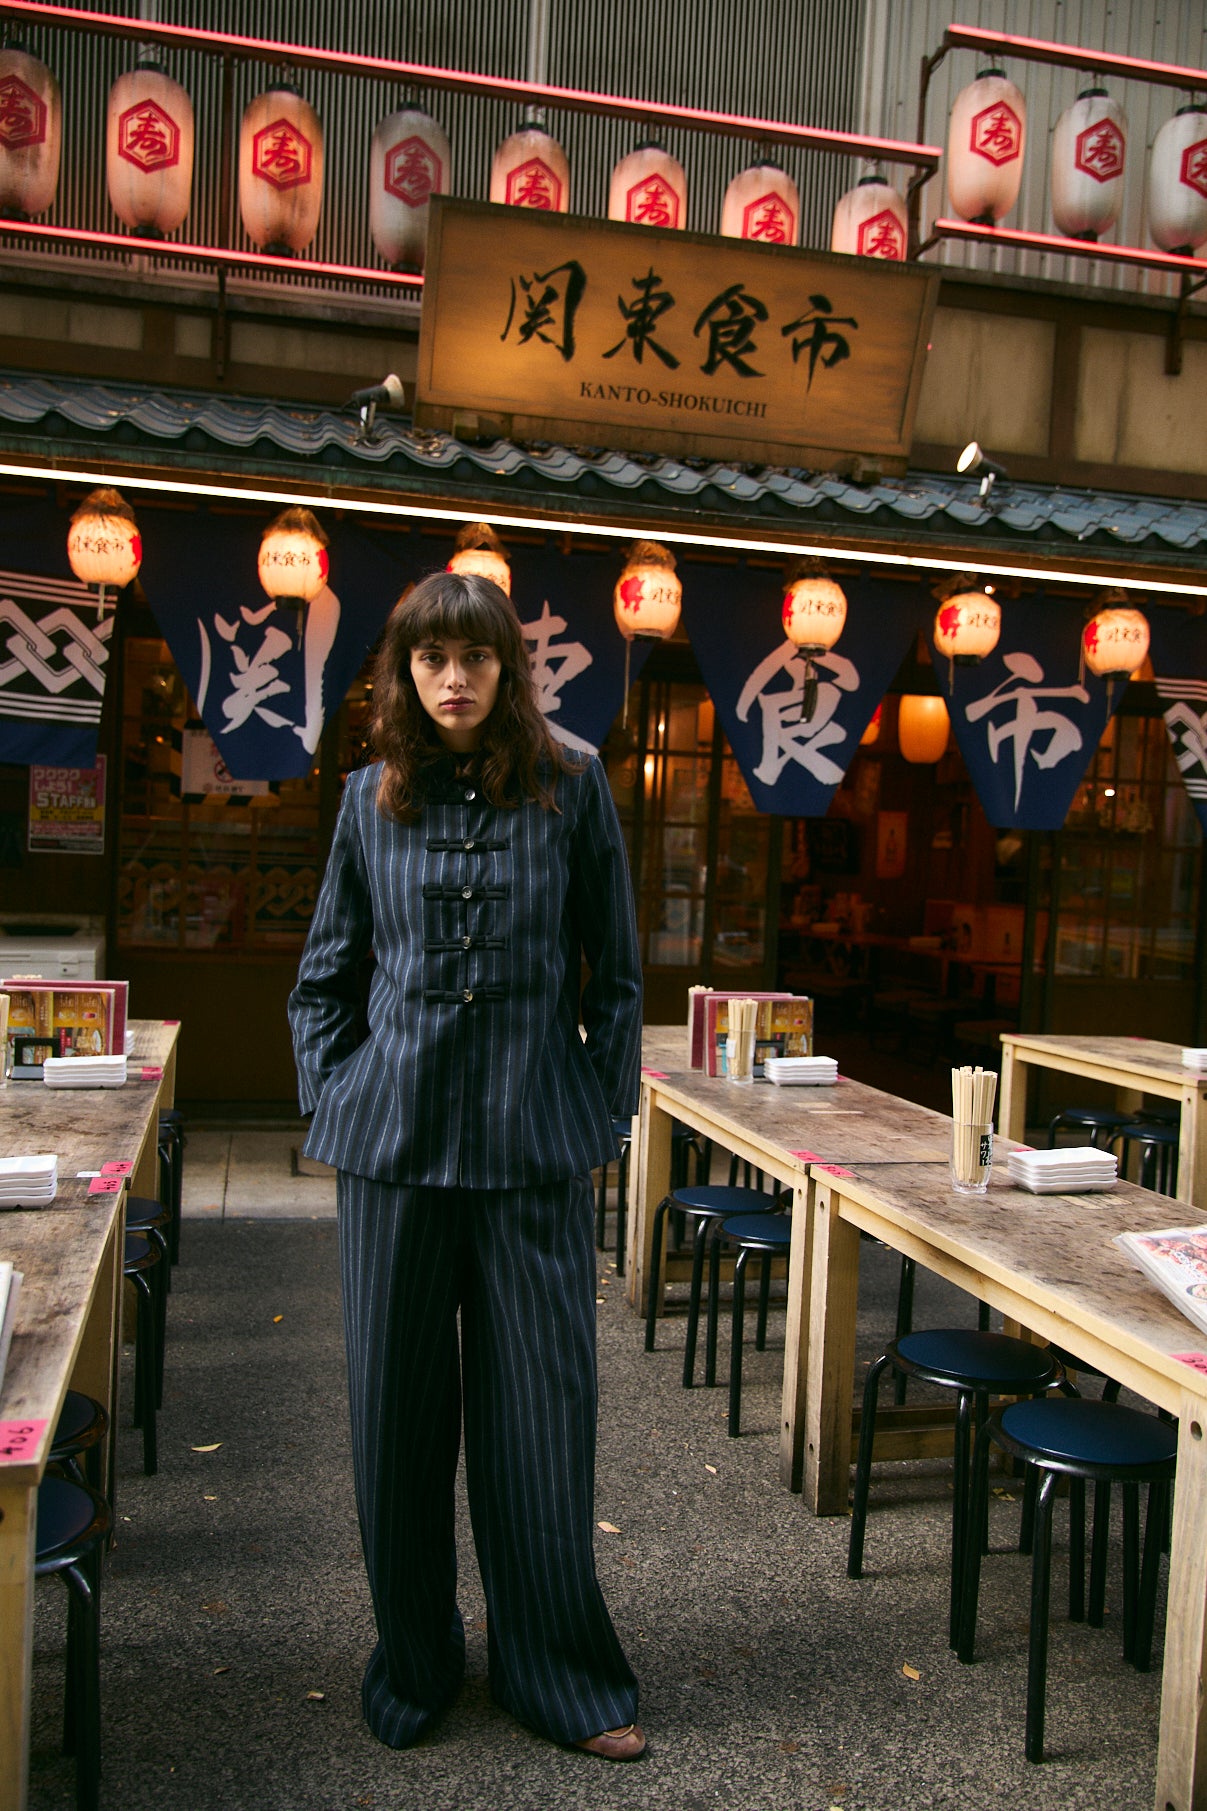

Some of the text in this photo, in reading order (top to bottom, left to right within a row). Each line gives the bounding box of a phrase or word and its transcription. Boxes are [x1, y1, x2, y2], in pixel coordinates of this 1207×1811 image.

[125, 112, 168, 161] 寿
[261, 132, 301, 178] 寿
[979, 112, 1013, 152] 寿
[501, 260, 859, 394] 関東食市
[579, 381, 768, 419] KANTO-SHOKUICHI
[197, 584, 341, 756] 関
[735, 638, 860, 786] 食
[965, 651, 1091, 813] 市
